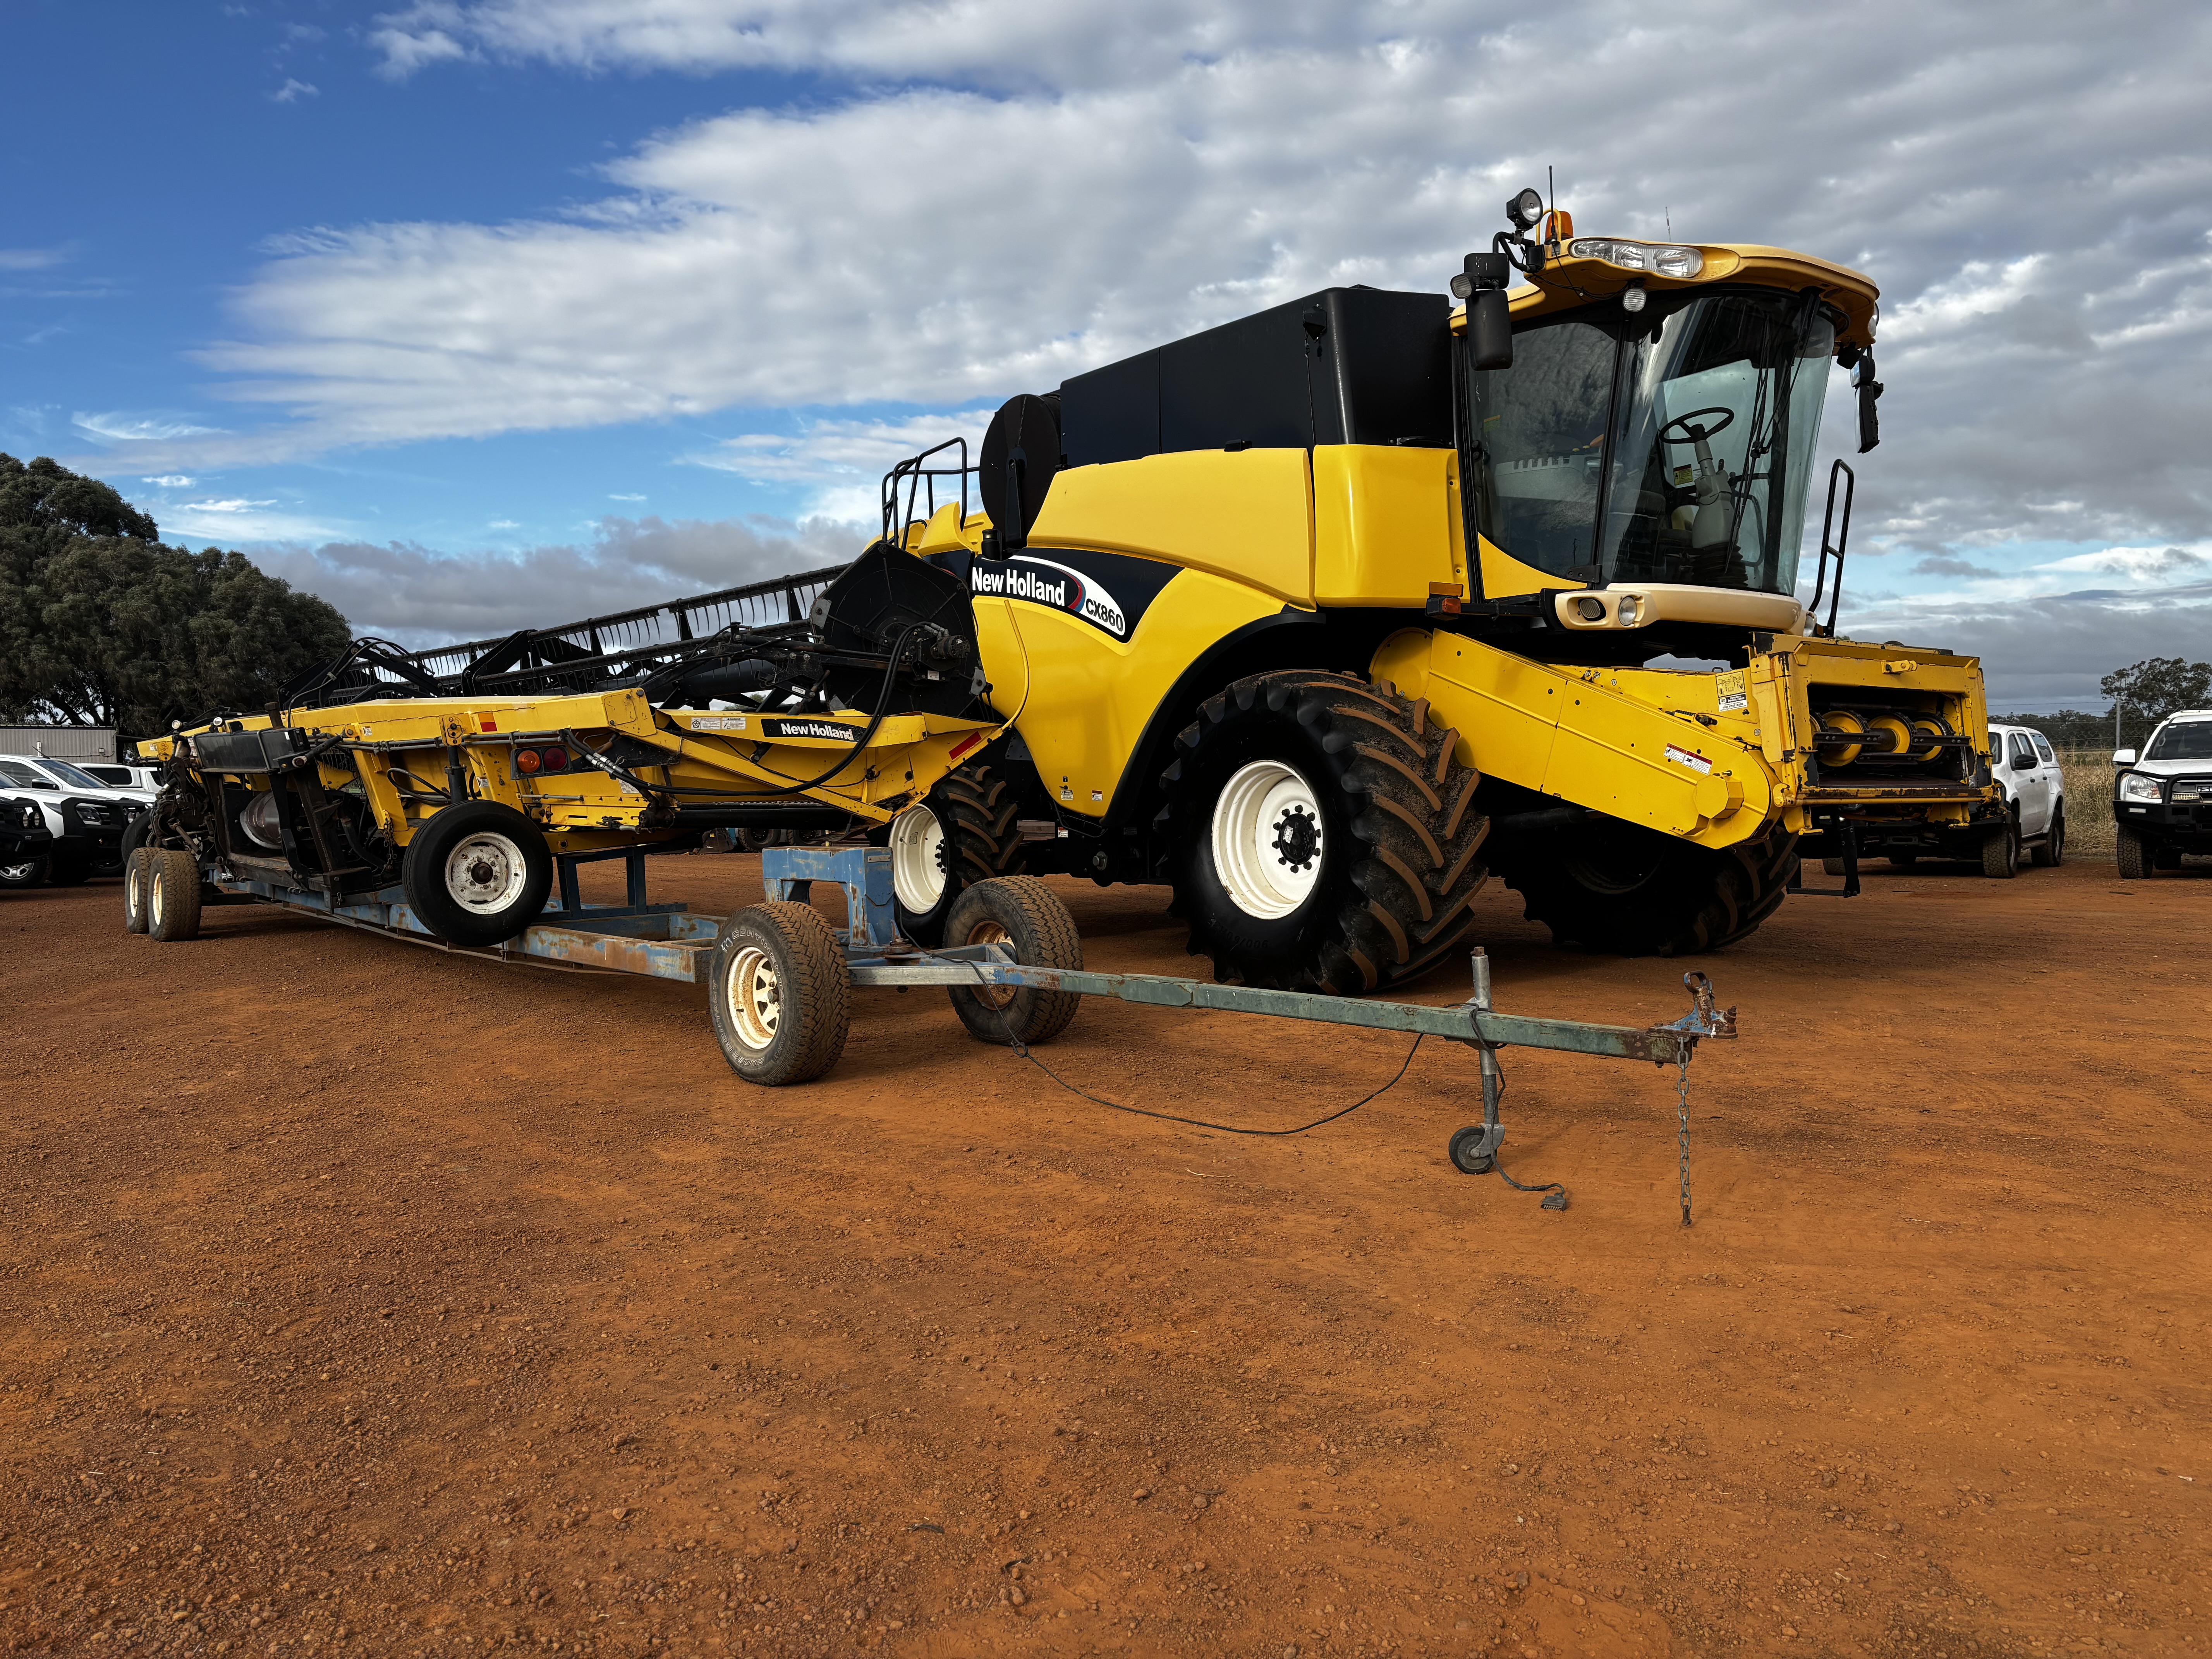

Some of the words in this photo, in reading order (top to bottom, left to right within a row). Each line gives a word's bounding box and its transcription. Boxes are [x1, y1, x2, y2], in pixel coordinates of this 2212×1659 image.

[972, 567, 1004, 592] New
[1006, 568, 1065, 606] Holland
[1085, 598, 1124, 632] CX860
[780, 723, 808, 735] New
[809, 723, 855, 740] Holland
